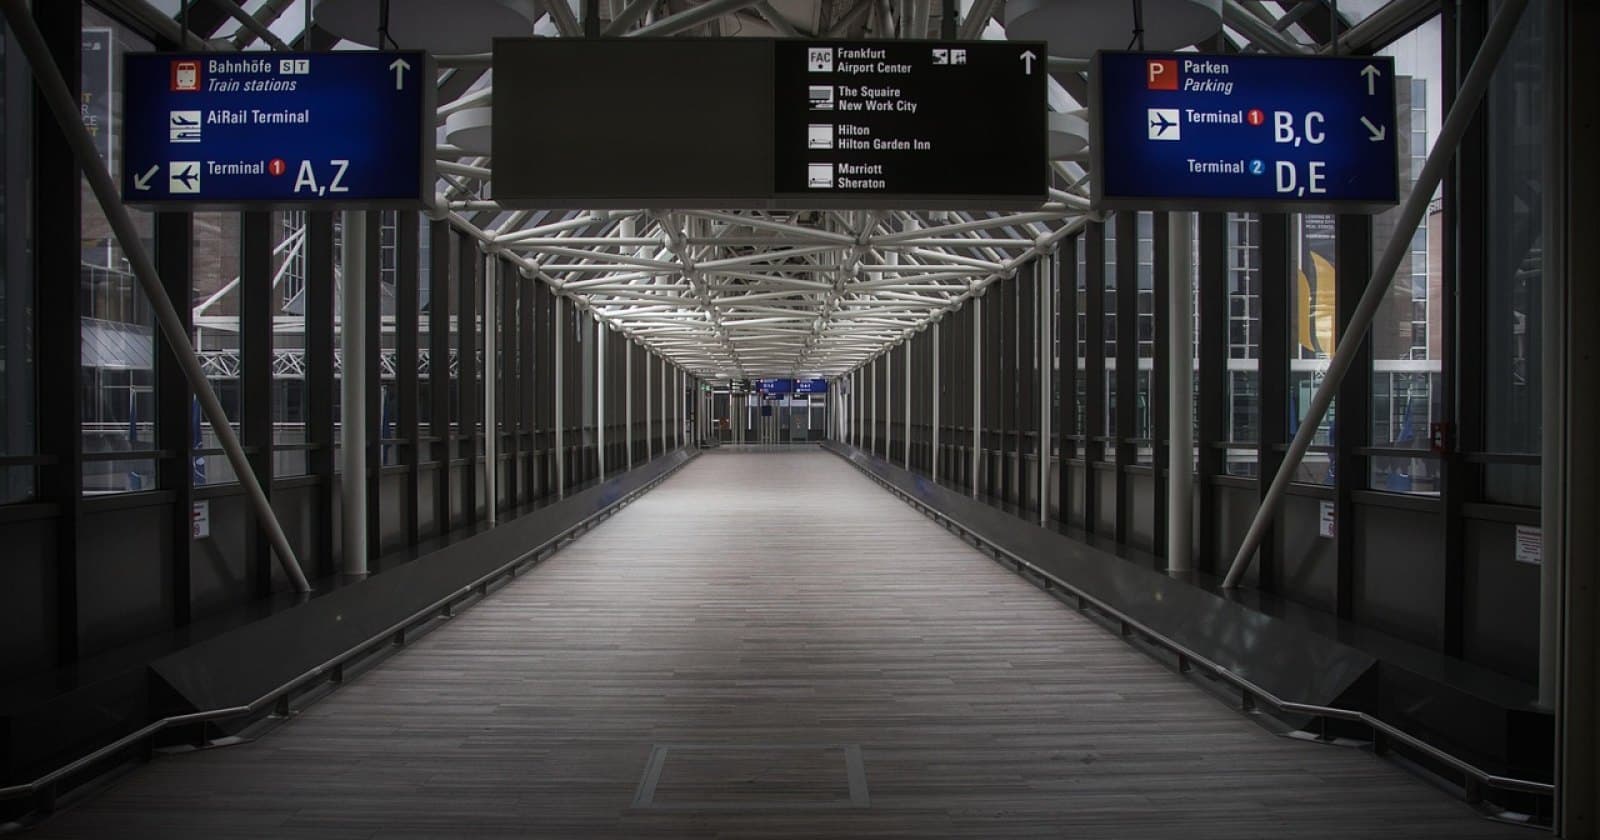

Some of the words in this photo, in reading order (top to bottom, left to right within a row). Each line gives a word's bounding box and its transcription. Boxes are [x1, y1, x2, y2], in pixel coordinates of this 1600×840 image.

[810, 52, 831, 63] FAC
[837, 47, 886, 59] Frankfurt
[208, 59, 272, 74] Bahnhöfe
[282, 61, 292, 73] S
[297, 61, 307, 73] T
[837, 62, 874, 76] Airport
[877, 61, 912, 73] Center
[1150, 63, 1165, 82] P
[1184, 60, 1229, 74] Parken
[208, 78, 240, 92] Train
[243, 78, 297, 92] stations
[838, 85, 858, 97] The
[860, 85, 901, 99] Squaire
[1184, 79, 1234, 95] Parking
[839, 100, 863, 112] New
[865, 100, 894, 112] Work
[896, 99, 917, 115] City
[207, 109, 247, 124] AiRail
[251, 109, 310, 124] Terminal
[838, 124, 870, 136] Hilton
[1185, 108, 1243, 124] Terminal
[1252, 110, 1259, 125] 1
[1273, 110, 1326, 147] B,C
[838, 138, 870, 150] Hilton
[873, 138, 911, 150] Garden
[914, 138, 931, 150] Inn
[838, 163, 883, 175] Marriott
[207, 160, 265, 175] Terminal
[273, 160, 281, 175] 1
[293, 159, 350, 197] A,Z
[838, 177, 886, 190] Sheraton
[1187, 158, 1245, 174] Terminal
[1252, 160, 1263, 174] 2
[1275, 160, 1327, 198] D,E
